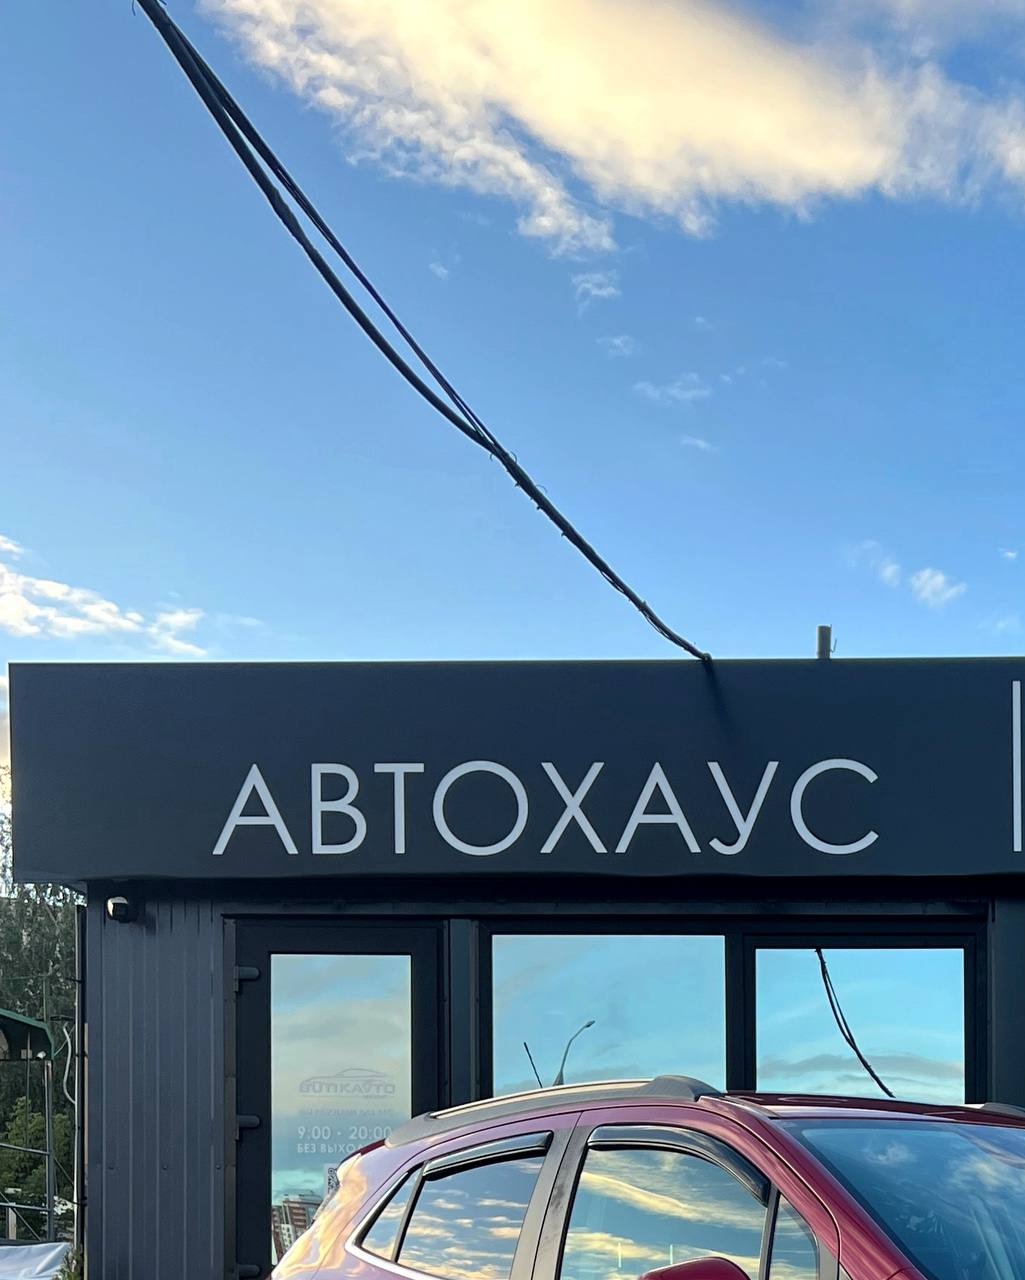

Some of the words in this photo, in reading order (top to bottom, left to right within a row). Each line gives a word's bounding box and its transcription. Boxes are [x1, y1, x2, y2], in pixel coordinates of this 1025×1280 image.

[213, 758, 880, 857] АВТОХАУС
[297, 1126, 331, 1140] 9:00
[348, 1126, 392, 1140] 20:00
[297, 1143, 317, 1154] БЕЗ
[320, 1143, 362, 1154] ВЫХО
